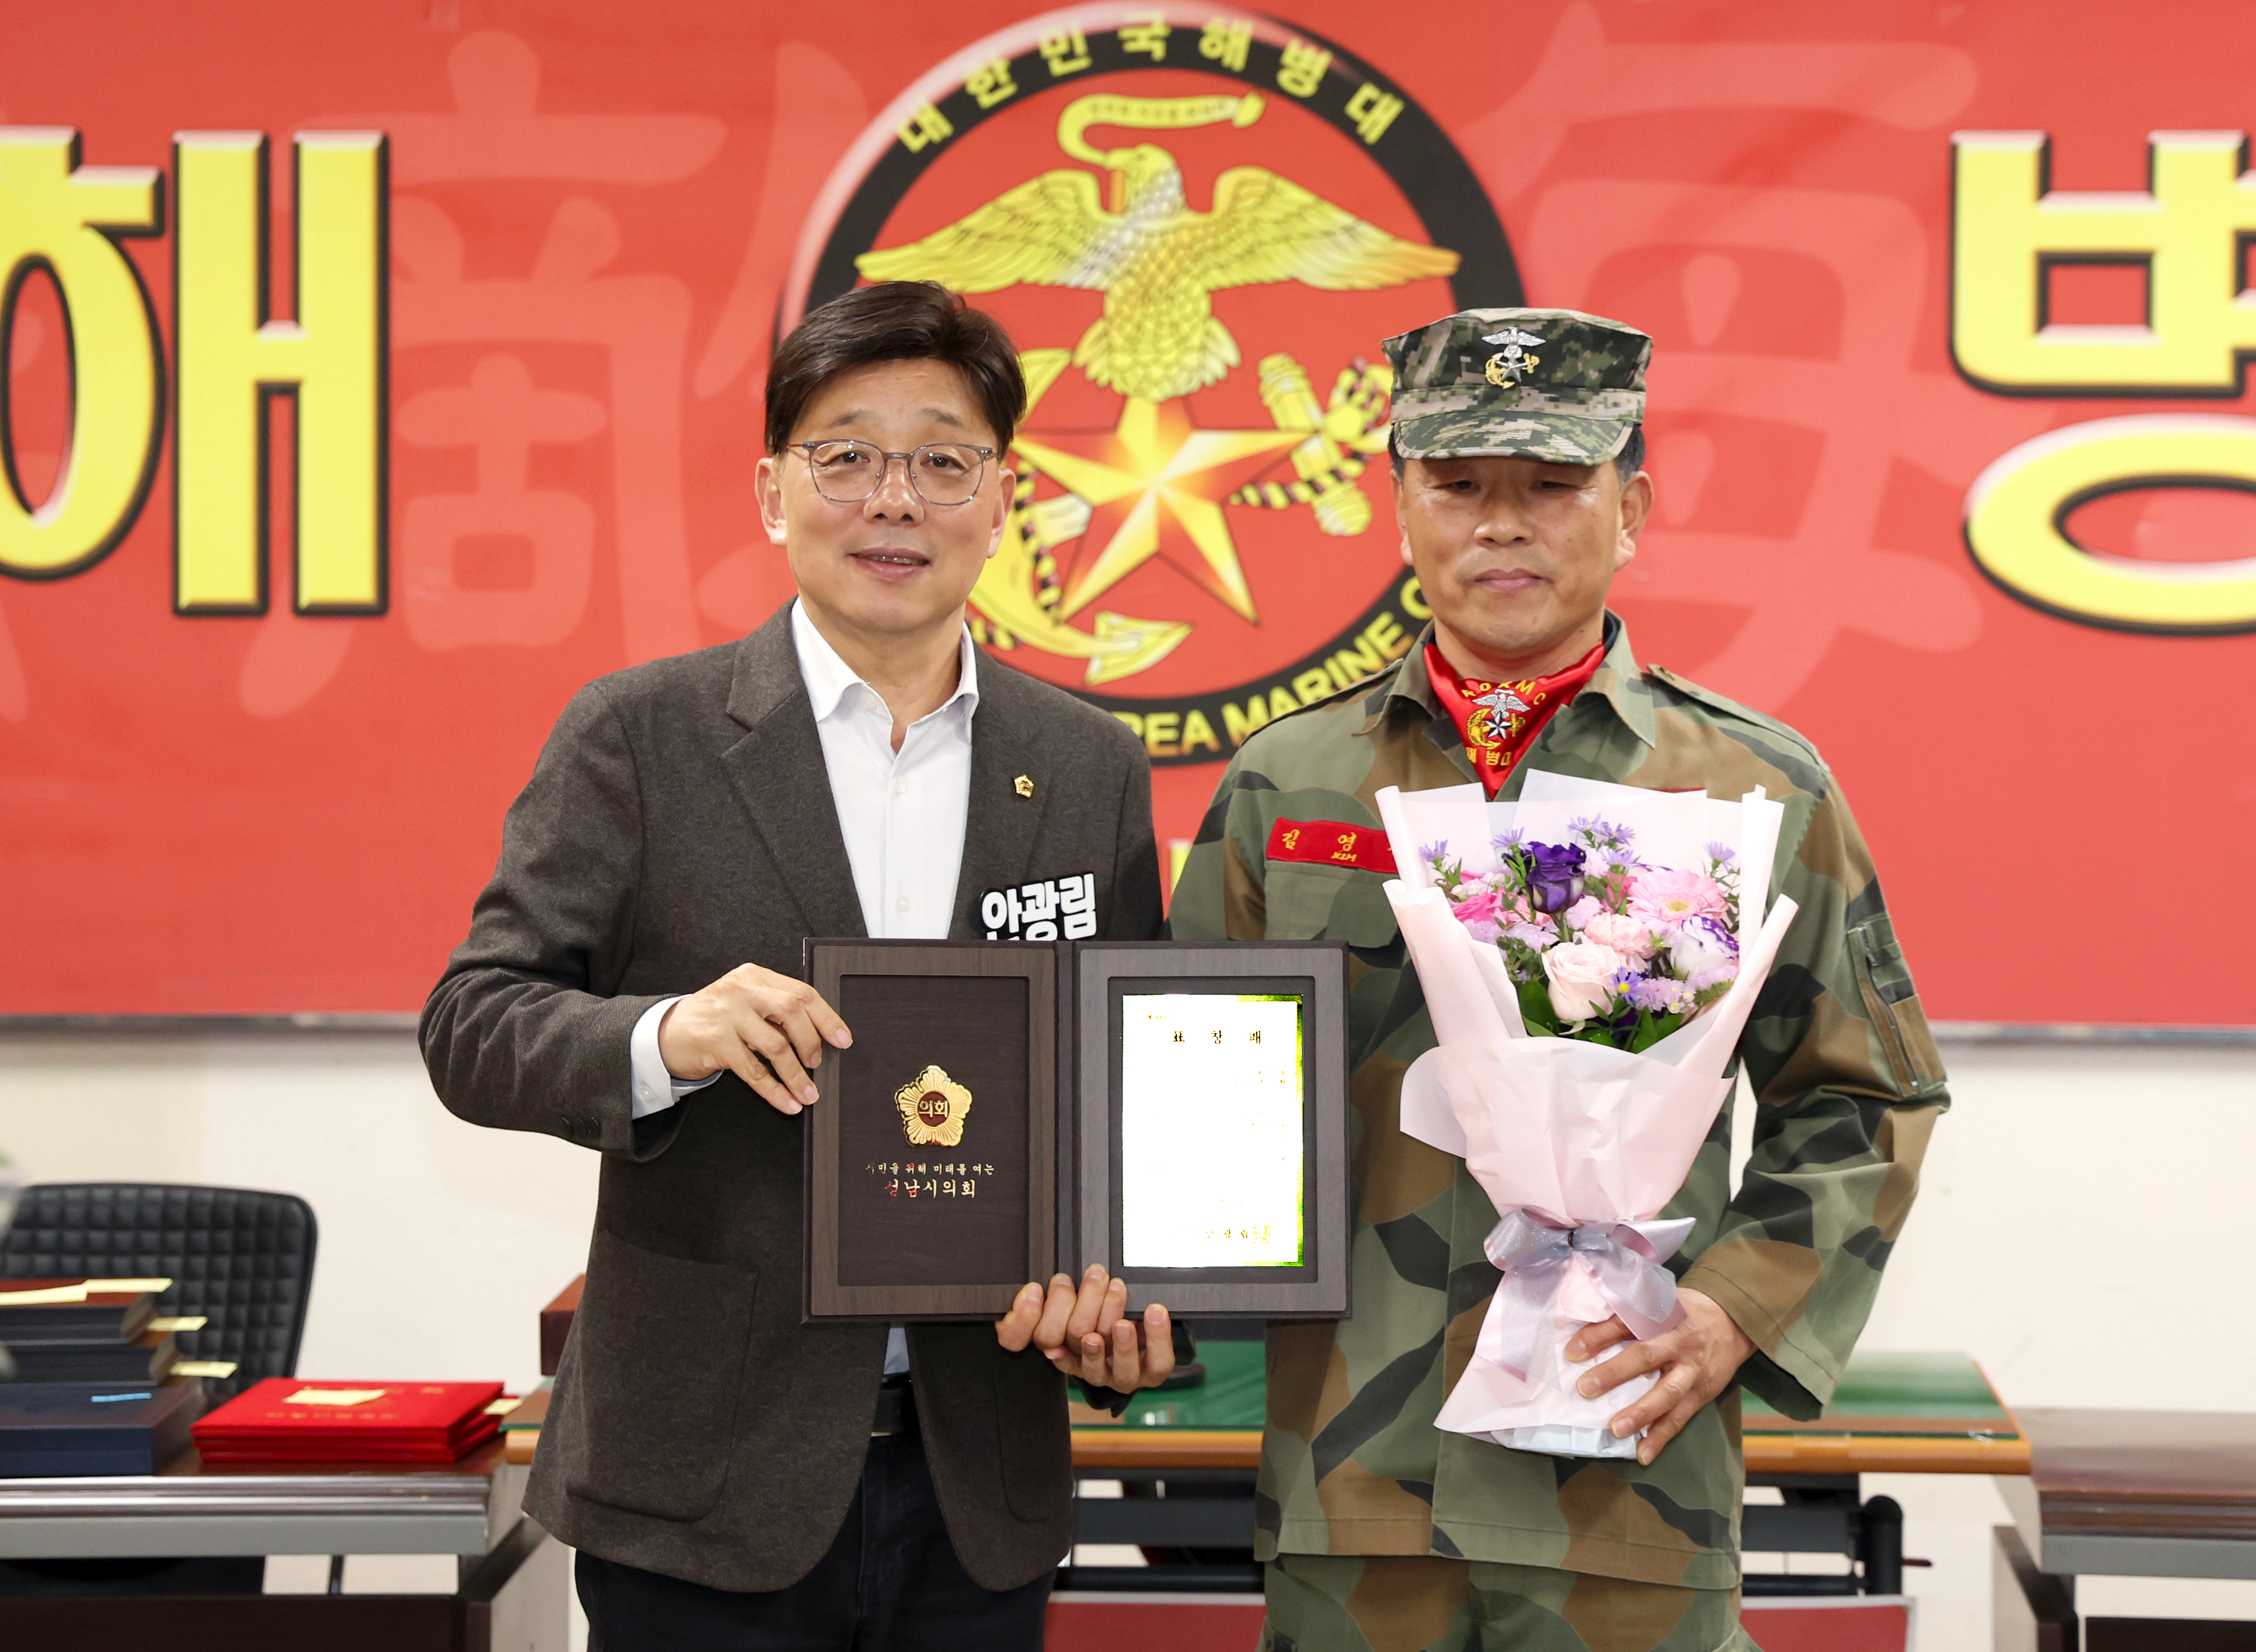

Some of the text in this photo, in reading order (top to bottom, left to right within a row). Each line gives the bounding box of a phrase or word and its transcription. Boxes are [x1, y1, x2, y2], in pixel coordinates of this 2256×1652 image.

[1221, 610, 1415, 747] MARINE
[919, 1100, 948, 1118] 의회
[865, 1162, 995, 1176] 시민을 위해 미래를 여는
[884, 1178, 976, 1198] 성남시의회
